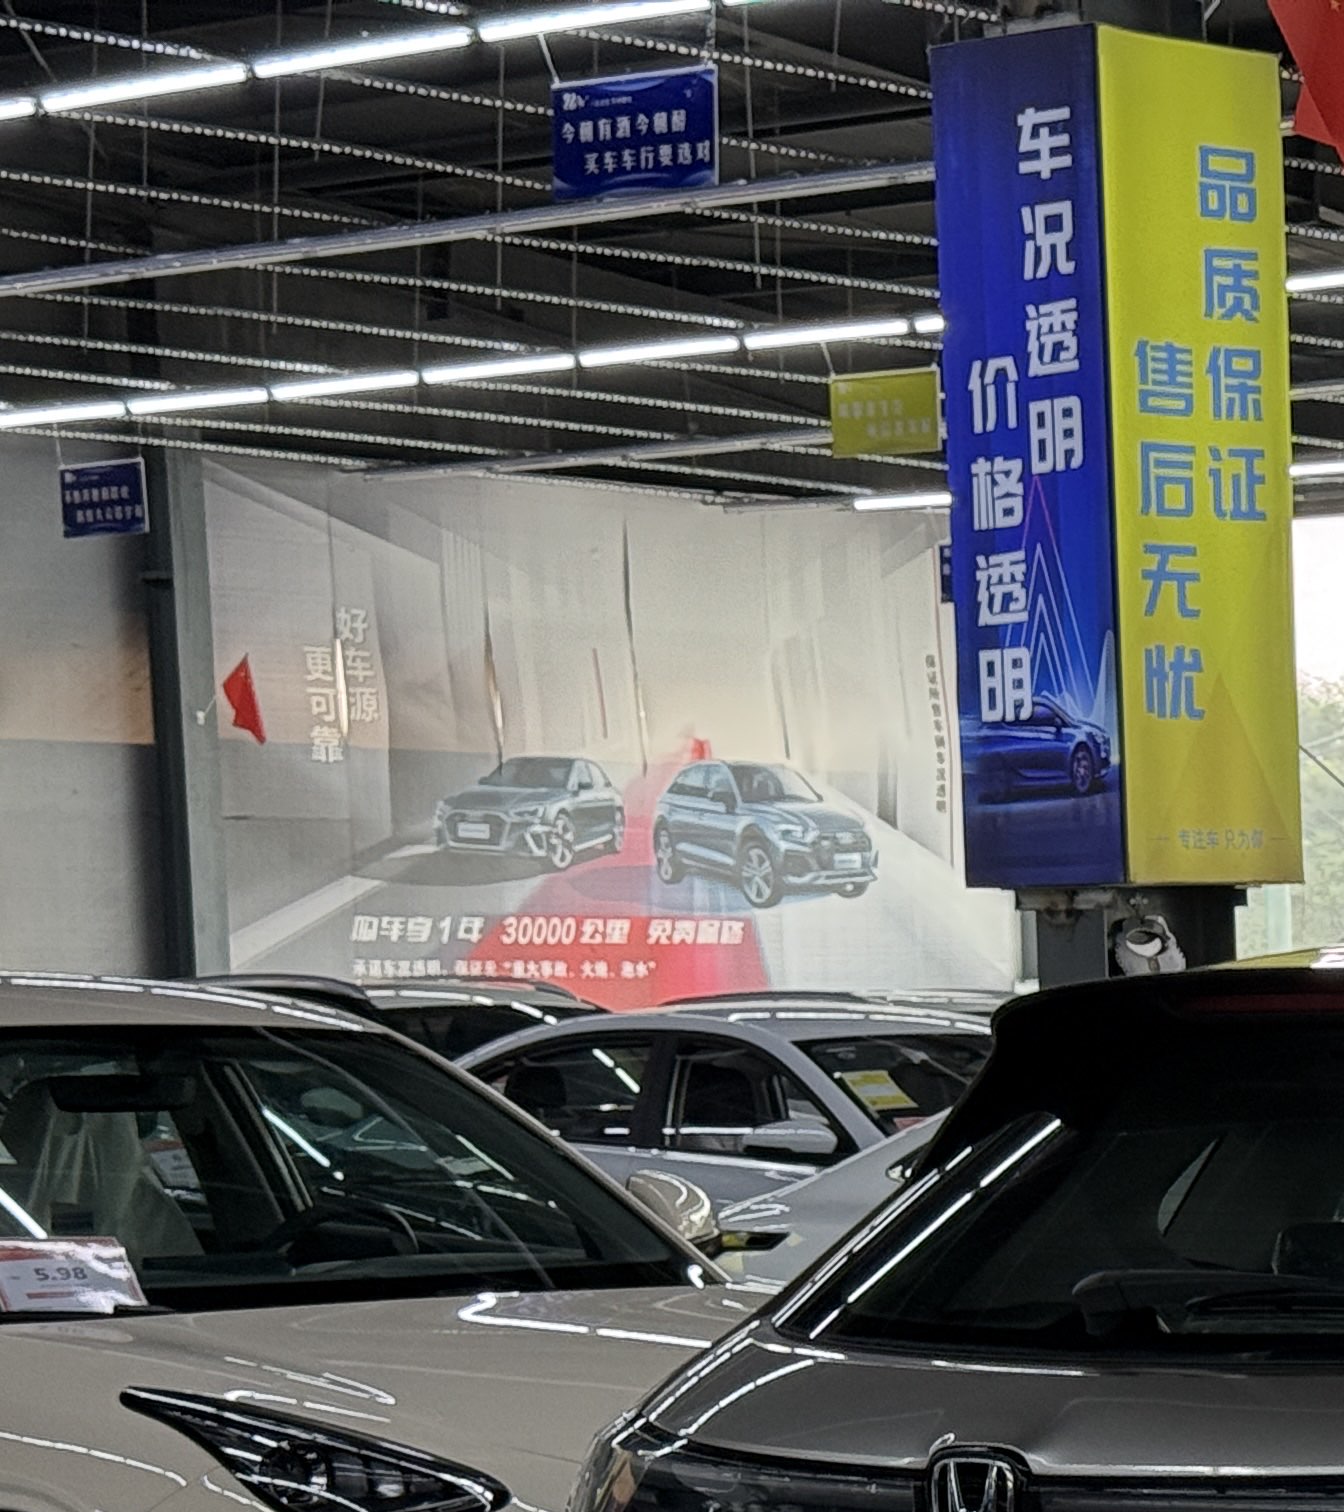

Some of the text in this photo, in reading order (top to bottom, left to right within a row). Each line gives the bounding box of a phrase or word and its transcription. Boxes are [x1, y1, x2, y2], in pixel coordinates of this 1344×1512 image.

[1017, 105, 1084, 475] 车况透明
[1197, 144, 1268, 521] 品质保证
[303, 645, 344, 763] 更可靠
[336, 606, 379, 723] 好车源
[967, 355, 1033, 724] 价格透明
[1133, 338, 1206, 721] 售后无忧
[34, 1267, 87, 1281] 5.98
